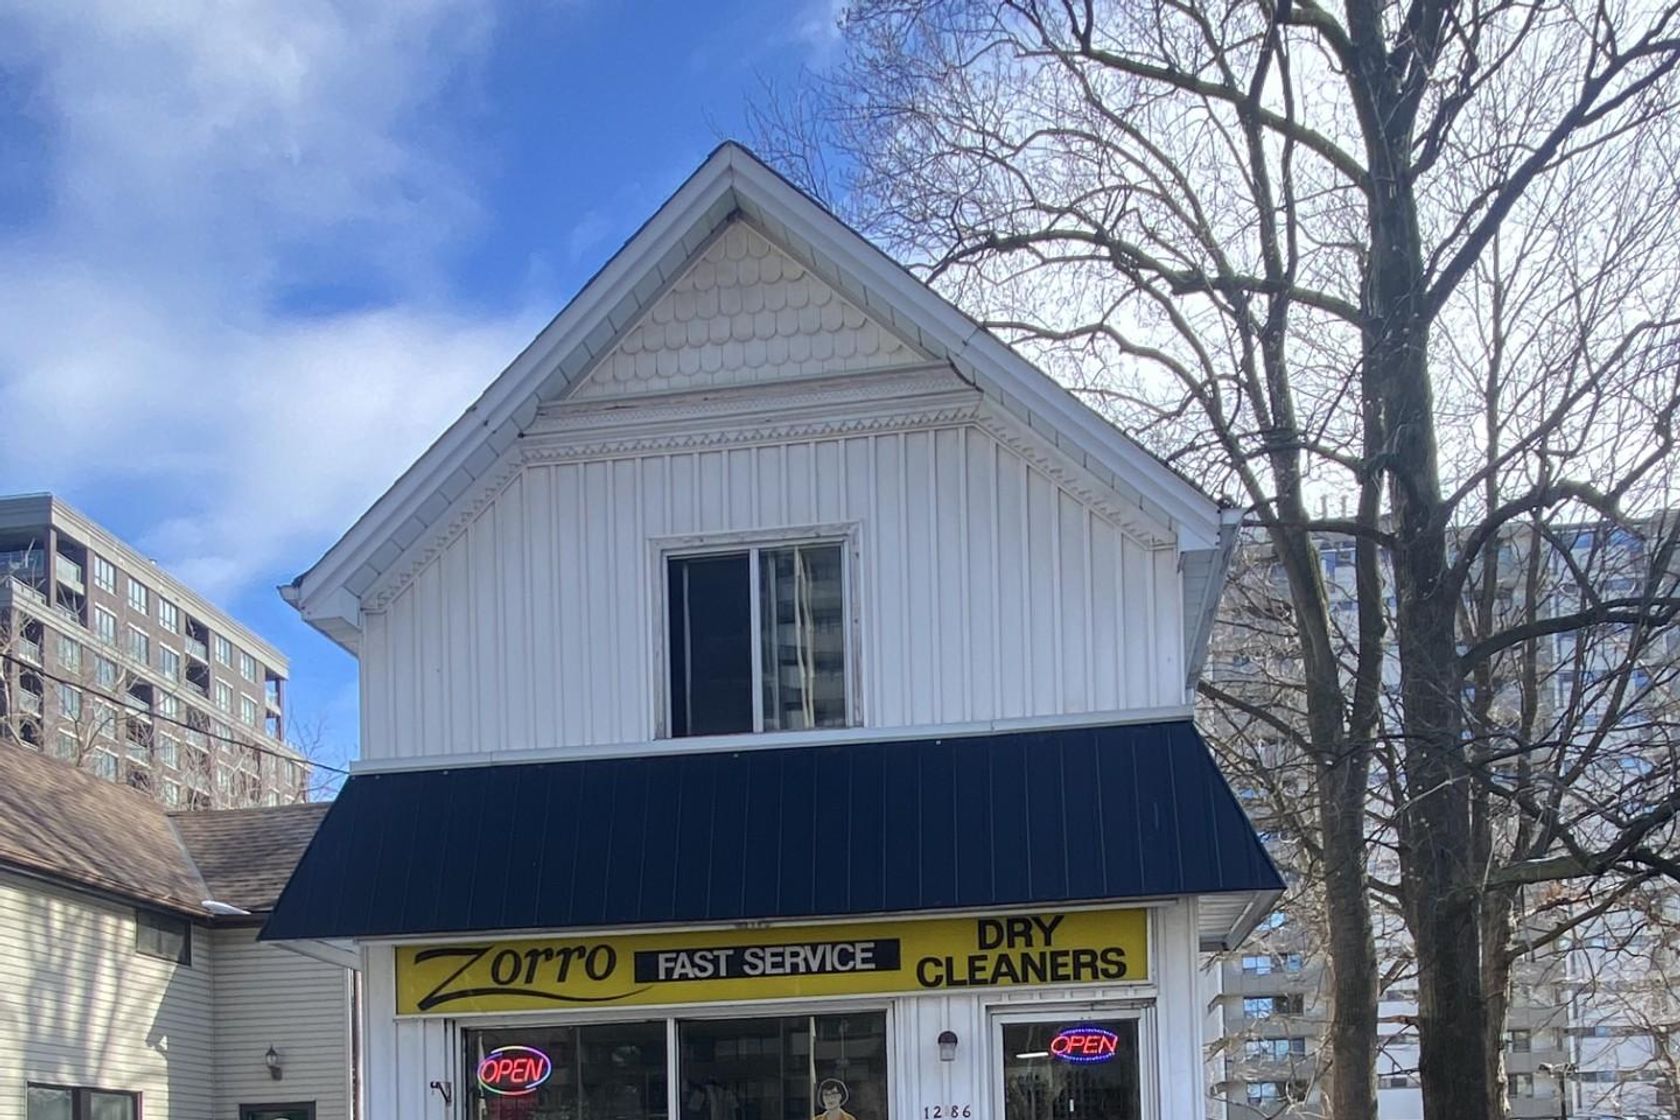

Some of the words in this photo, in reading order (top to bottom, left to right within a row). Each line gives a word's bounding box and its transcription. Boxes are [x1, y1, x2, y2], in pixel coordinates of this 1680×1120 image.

[977, 914, 1064, 950] DRY
[414, 943, 653, 1011] Zorro
[657, 949, 733, 980] FAST
[742, 941, 876, 976] SERVICE
[916, 946, 1127, 988] CLEANERS
[1050, 1035, 1118, 1055] OPEN
[481, 1057, 544, 1083] OPEN
[923, 1104, 971, 1120] 1286
